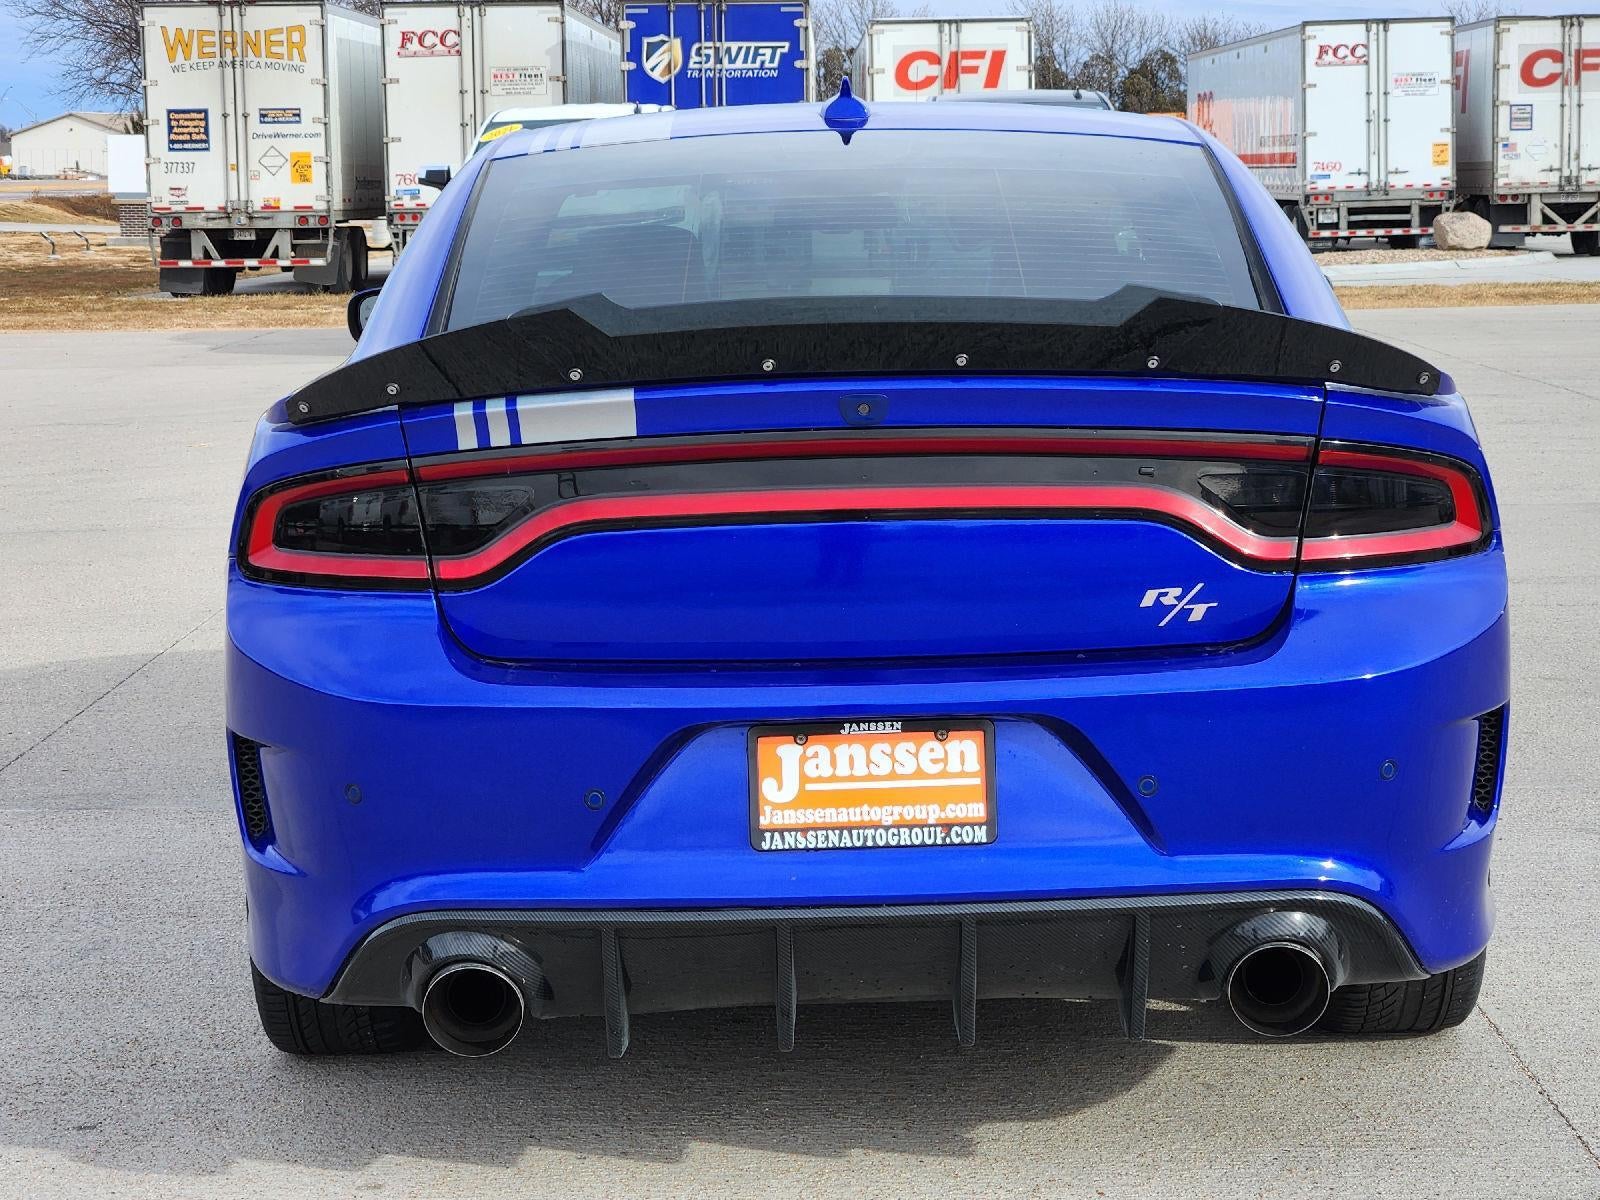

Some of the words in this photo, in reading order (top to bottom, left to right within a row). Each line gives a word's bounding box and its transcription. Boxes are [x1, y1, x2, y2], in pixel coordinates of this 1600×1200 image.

[160, 25, 307, 63] WERNER
[398, 29, 460, 50] FCC
[688, 42, 790, 68] SWIFT
[1316, 43, 1368, 60] FCC
[171, 64, 187, 74] WE
[189, 62, 215, 71] KEEP
[218, 61, 262, 70] AMERICA
[264, 61, 305, 74] MOVING
[686, 69, 778, 78] TRANSPORTATION
[895, 50, 1007, 91] CFI
[252, 132, 322, 140] DriveWerner.com
[163, 161, 196, 174] 377337
[1139, 582, 1219, 627] R/T
[840, 721, 902, 735] JANSSEN
[761, 739, 981, 803] Janssen
[760, 802, 986, 826] Janssenautogroup.com
[761, 825, 988, 850] JANSSENAUTOGROUP.COM
